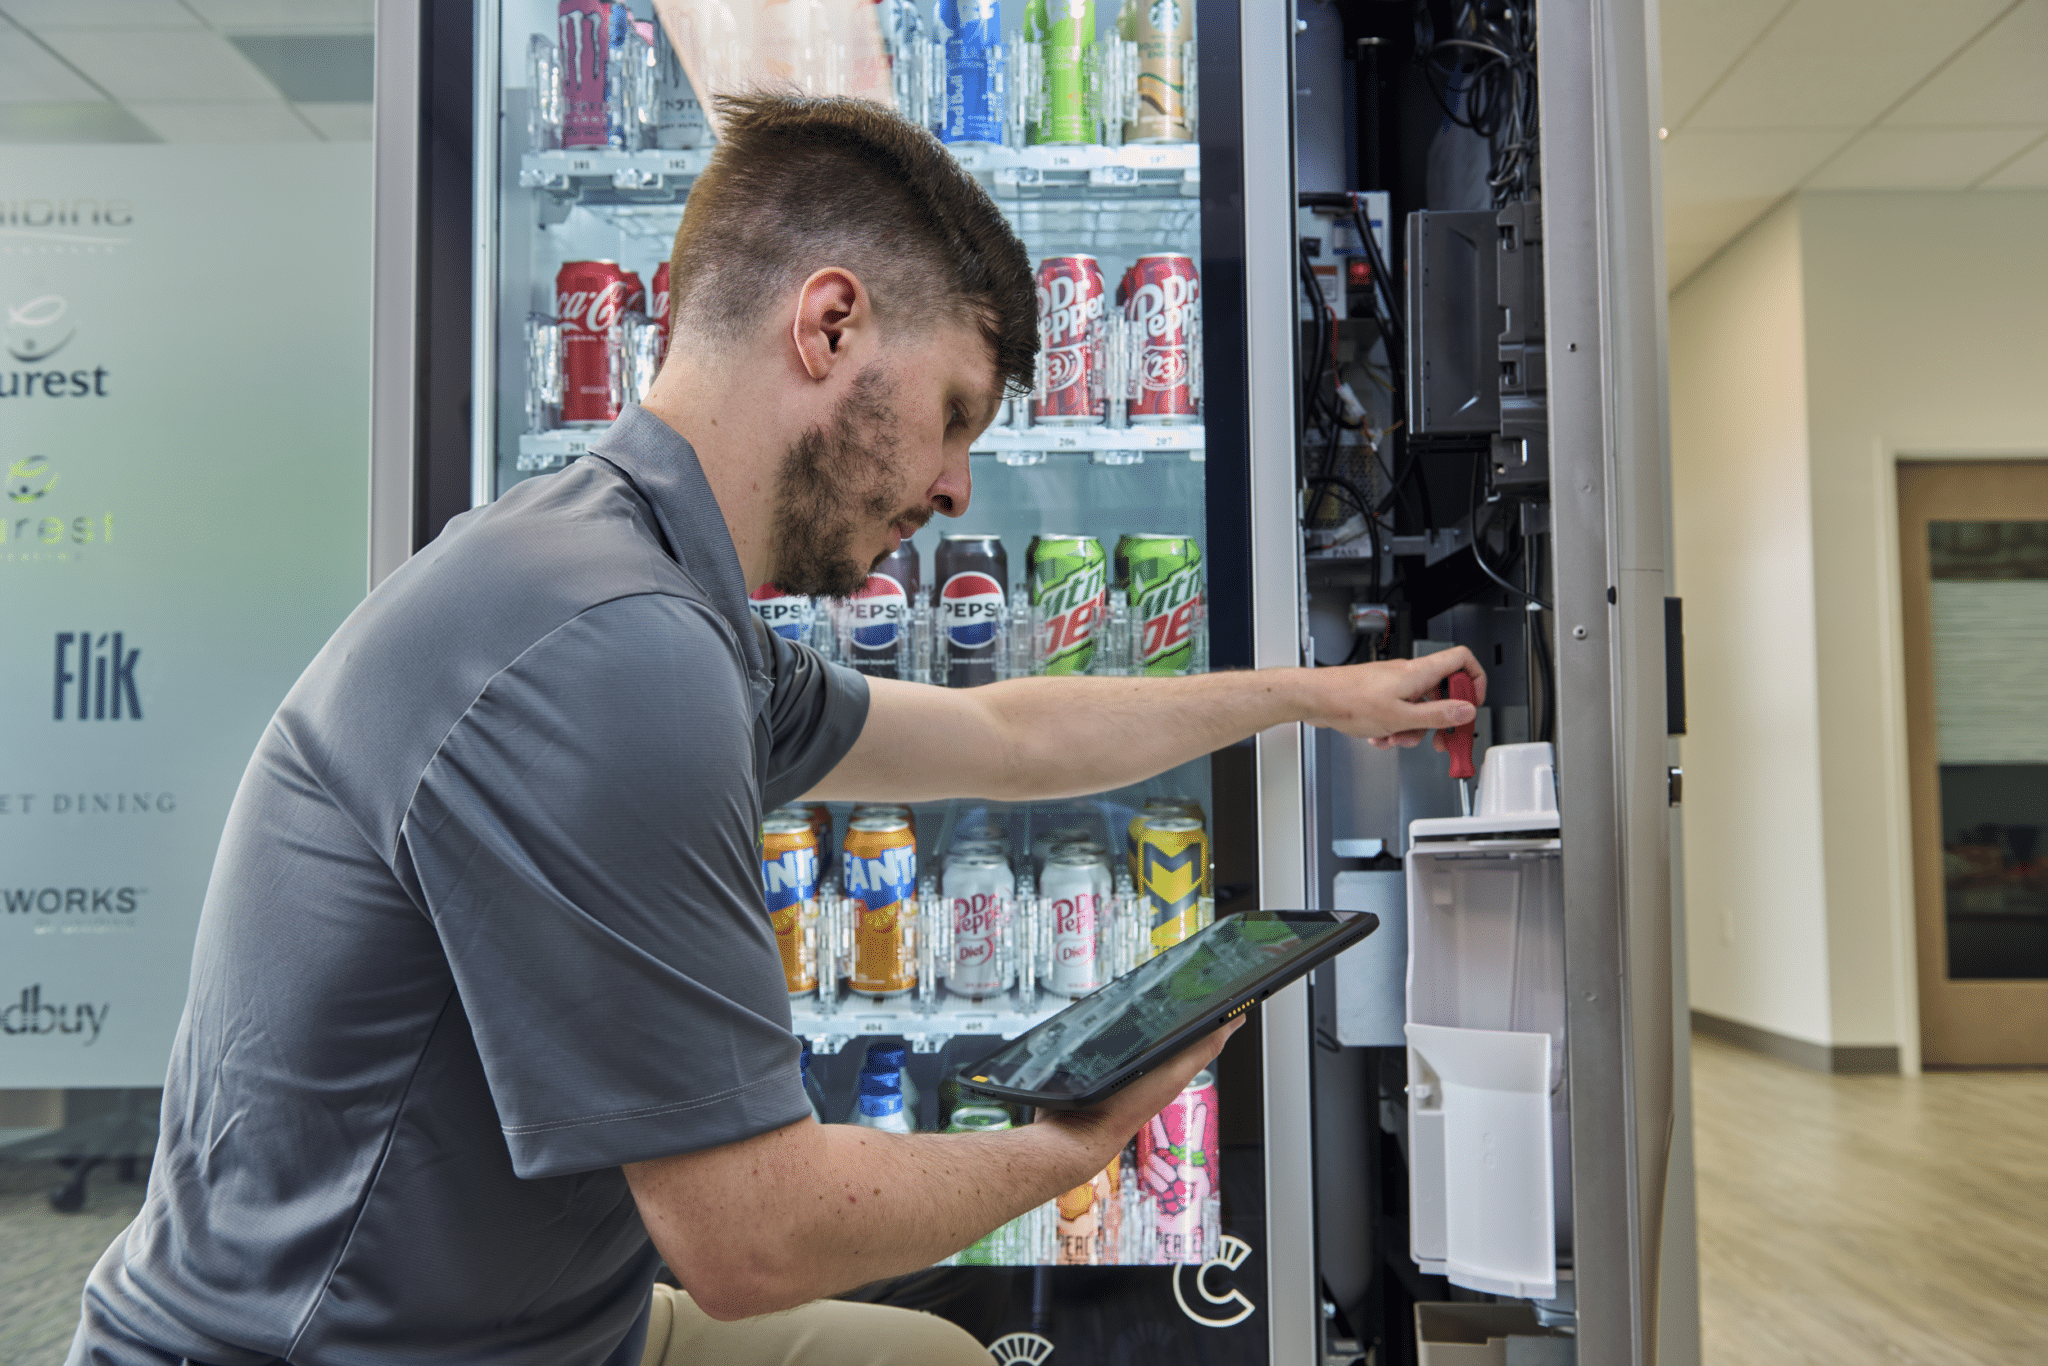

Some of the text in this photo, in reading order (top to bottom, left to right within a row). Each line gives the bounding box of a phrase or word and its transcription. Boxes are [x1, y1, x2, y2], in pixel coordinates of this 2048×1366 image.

[1050, 276, 1091, 312] Dr
[1162, 275, 1198, 310] Dr
[1150, 355, 1176, 380] 23
[1058, 437, 1075, 447] 206
[749, 604, 806, 620] PEPS
[848, 604, 905, 619] EPS
[53, 792, 177, 815] DINING
[0, 887, 137, 914] WORKS
